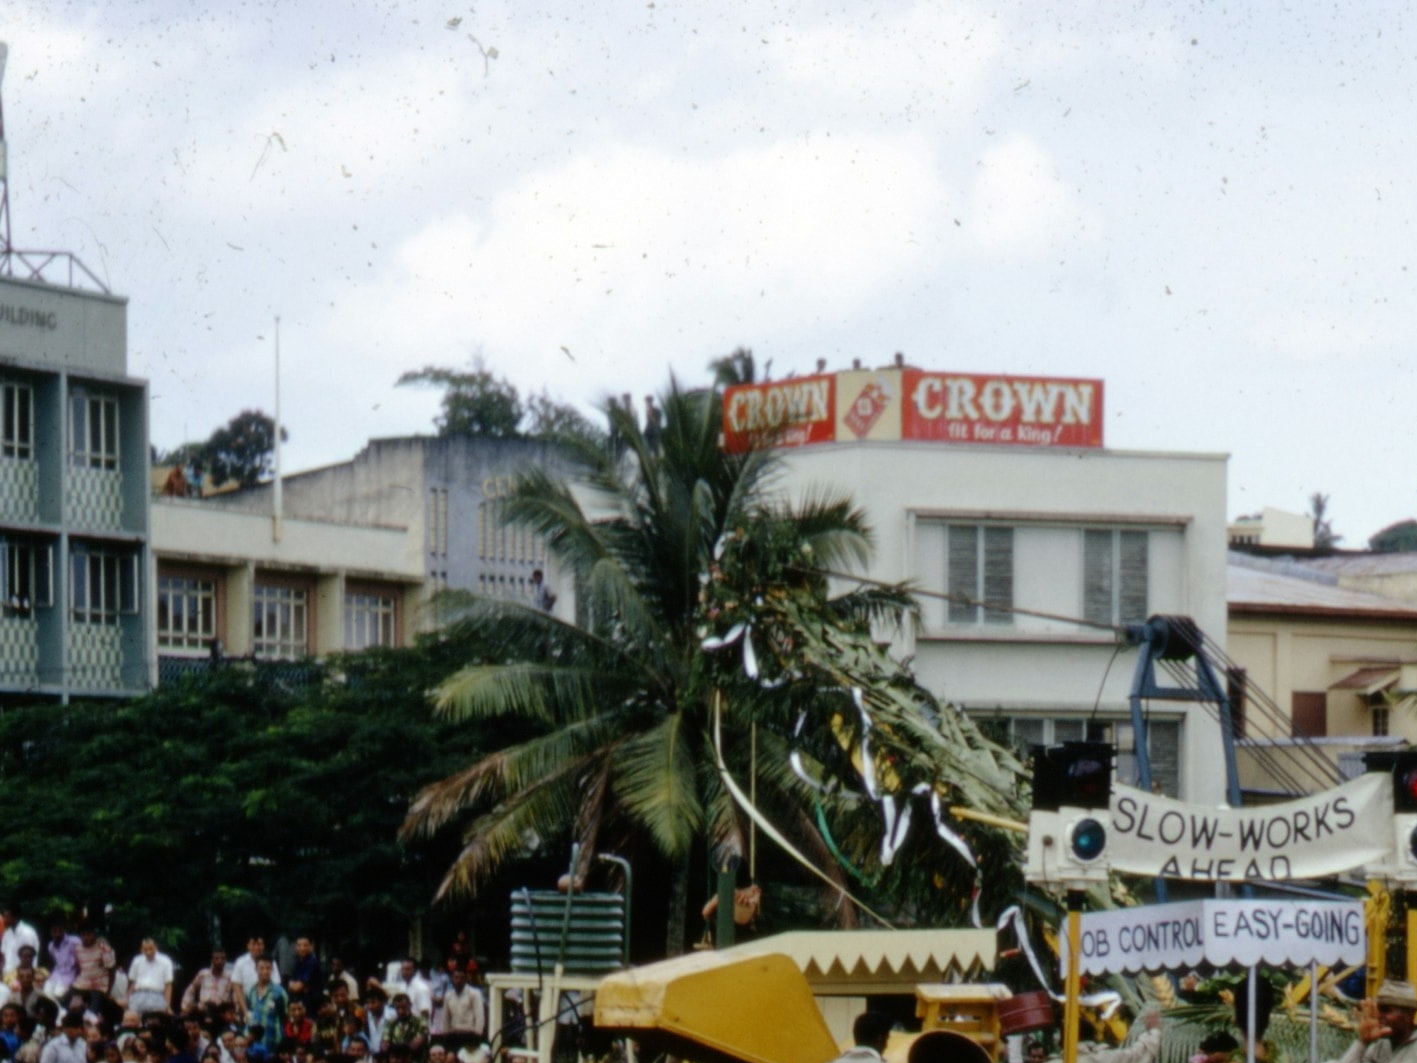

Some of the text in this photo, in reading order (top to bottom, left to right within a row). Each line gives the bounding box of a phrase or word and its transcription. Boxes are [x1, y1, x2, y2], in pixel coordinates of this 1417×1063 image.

[728, 378, 830, 433] CROWN
[911, 376, 1093, 425] CROWN
[948, 423, 968, 439] fit
[974, 423, 995, 440] for
[1000, 428, 1013, 440] a
[1112, 797, 1355, 851] SLOW-WORKS
[1082, 918, 1203, 957] OB CONTROL
[1213, 908, 1360, 946] EASY-GOING
